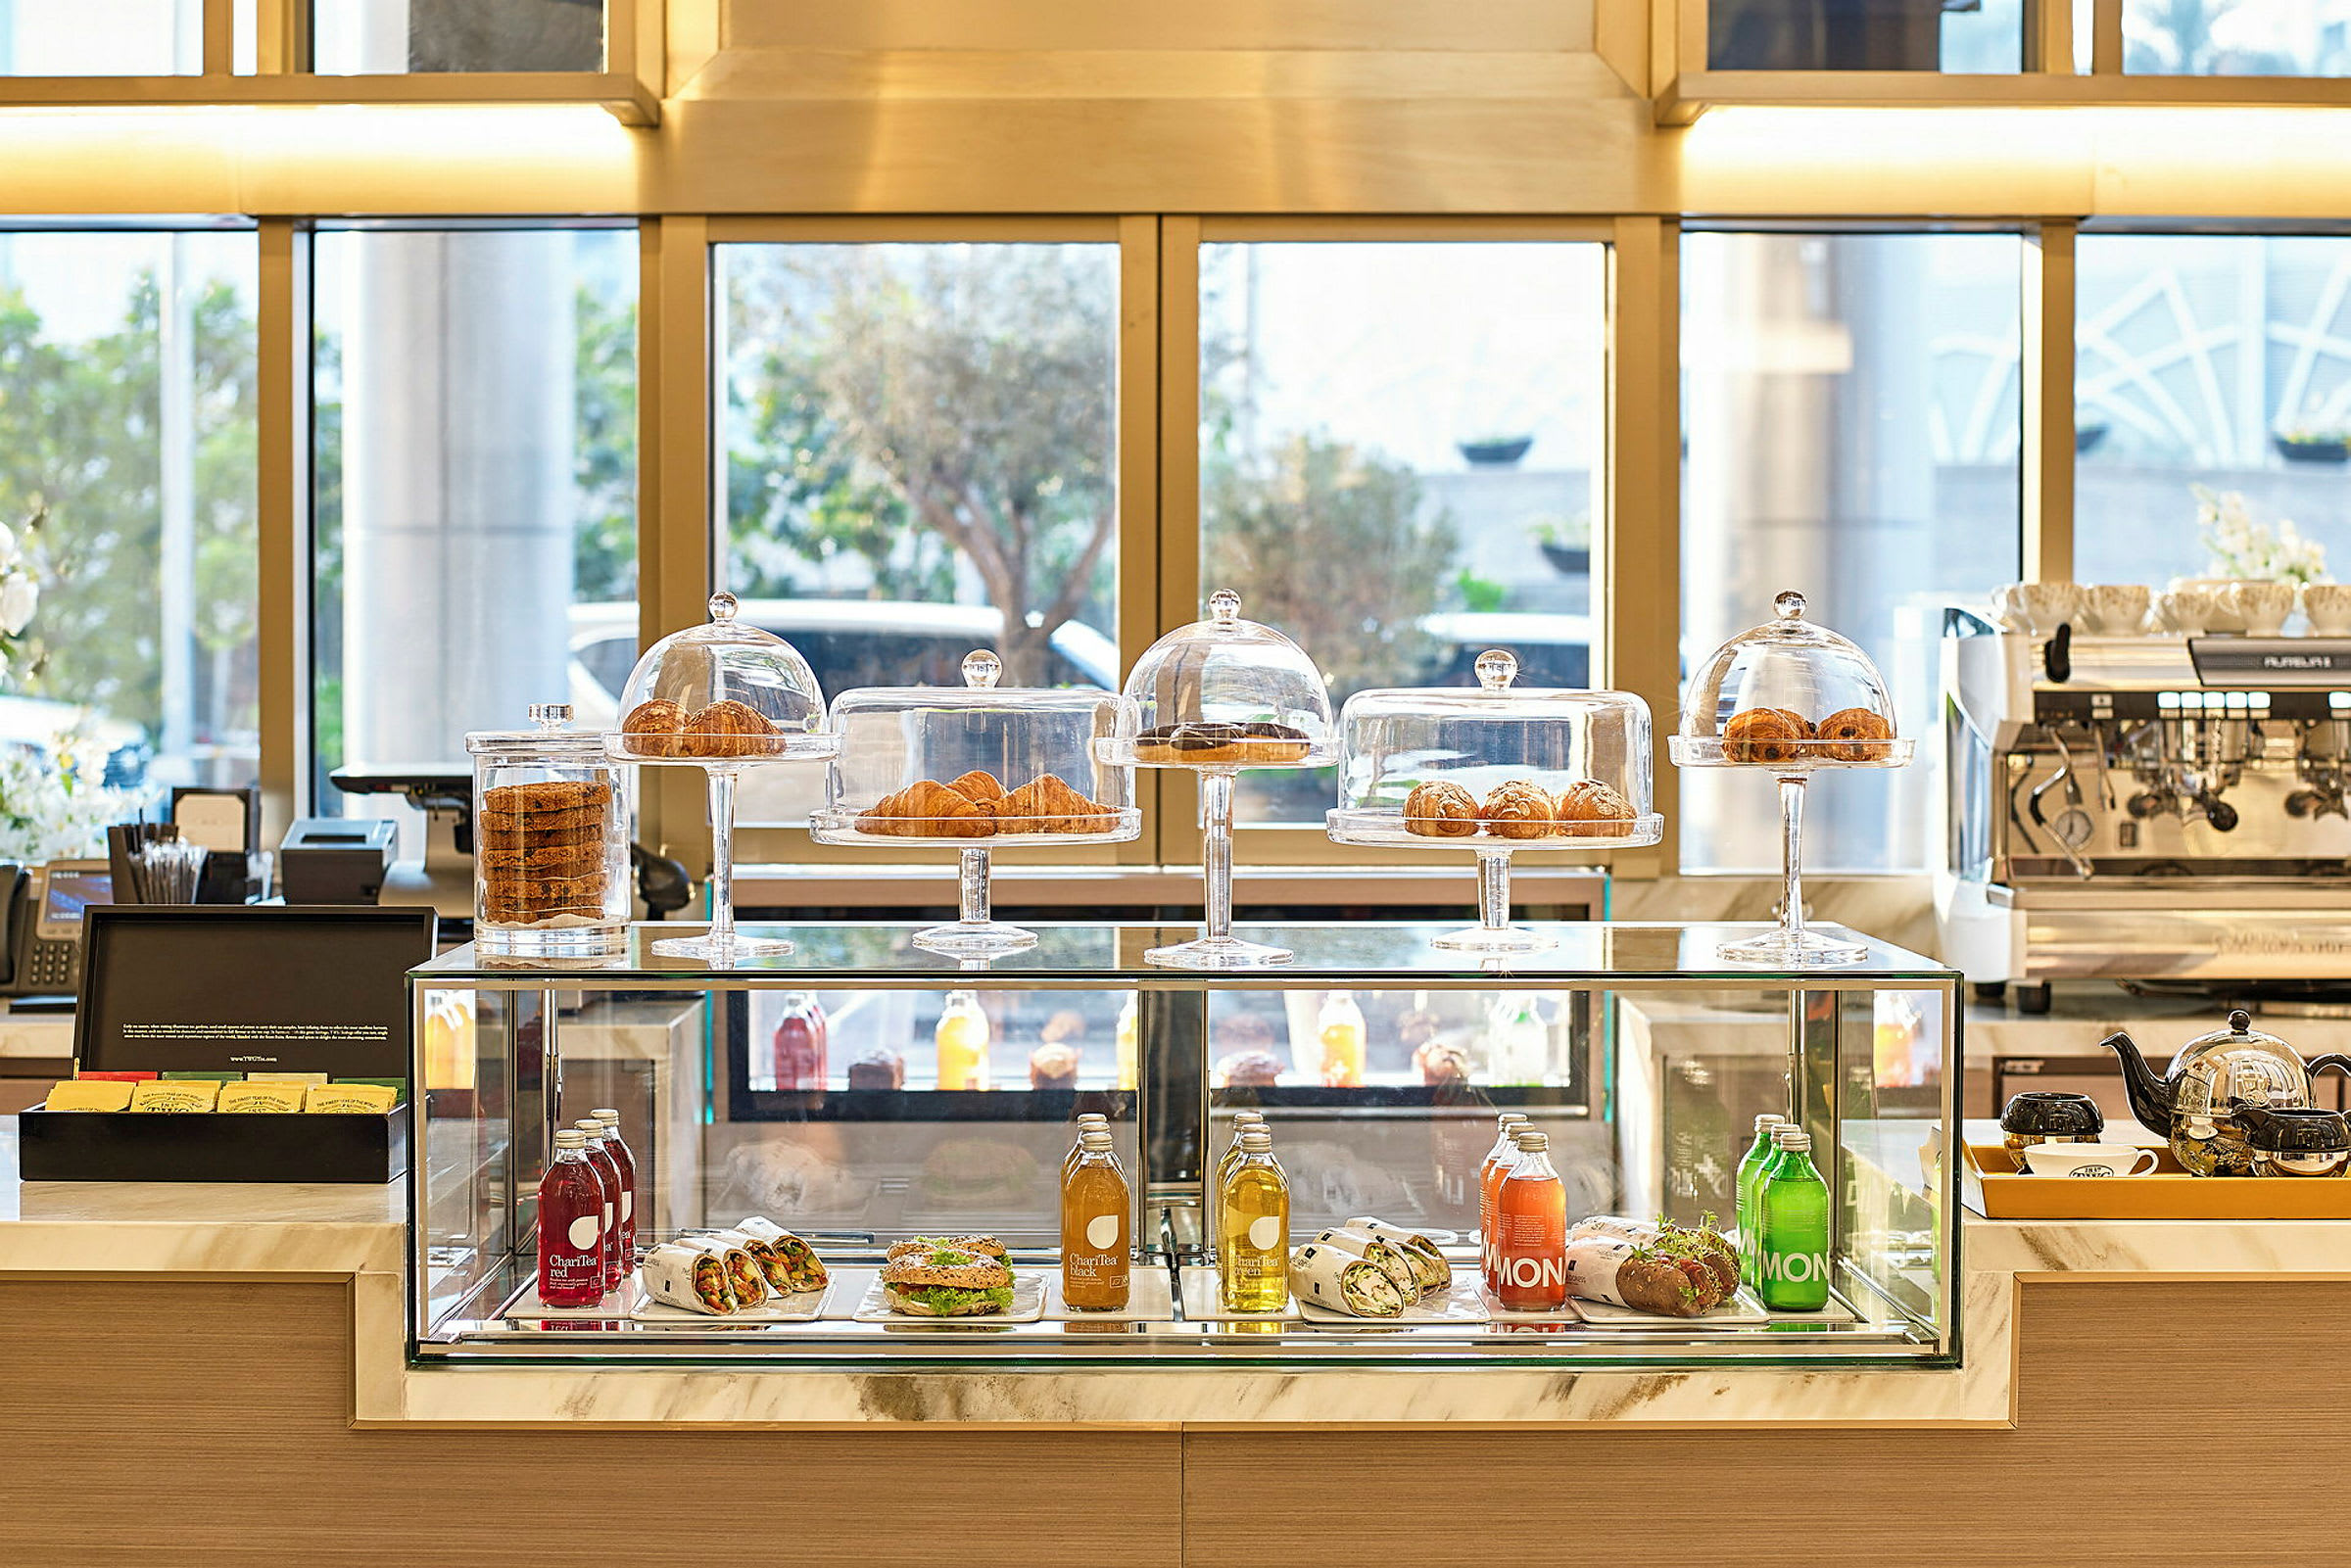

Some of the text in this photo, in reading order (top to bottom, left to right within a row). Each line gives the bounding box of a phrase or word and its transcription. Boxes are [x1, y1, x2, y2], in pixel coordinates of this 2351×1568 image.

[549, 1254, 598, 1267] ChariTea
[1069, 1252, 1119, 1266] ChariTea
[1230, 1255, 1279, 1267] hariTea
[550, 1266, 568, 1278] red
[1070, 1264, 1097, 1277] black
[1498, 1257, 1566, 1288] MON
